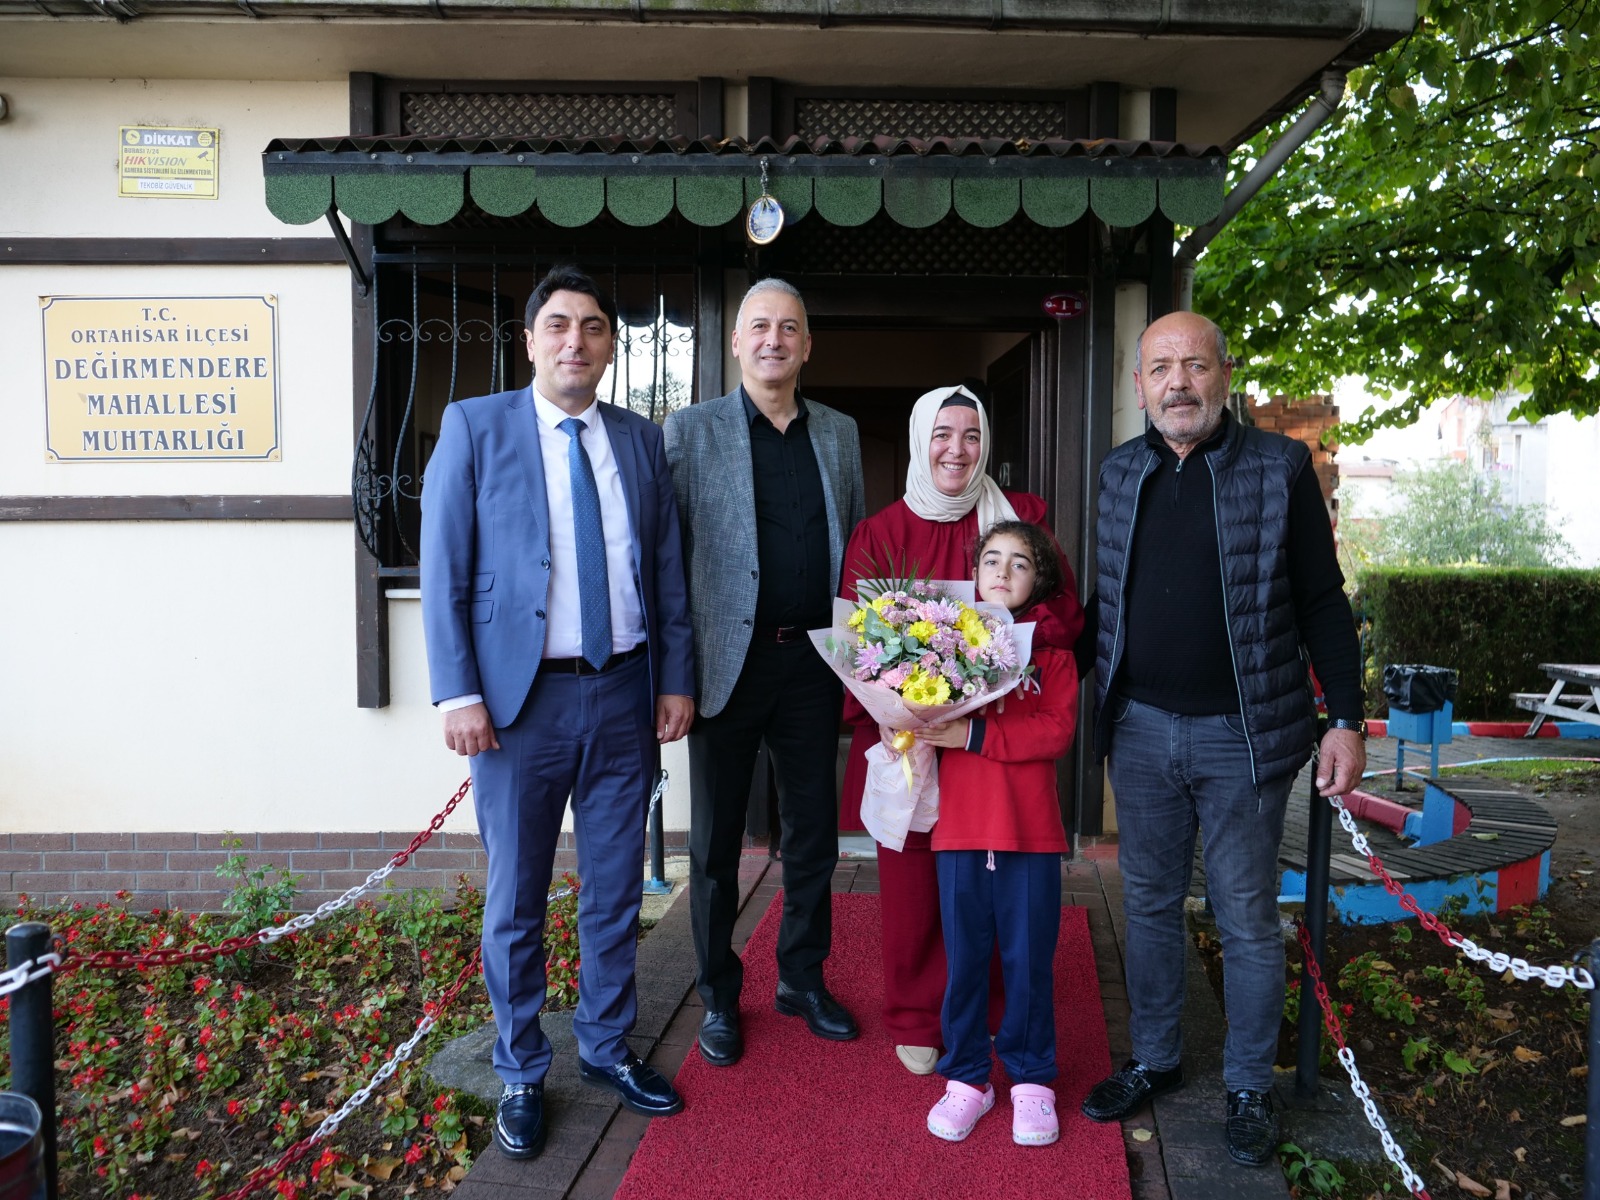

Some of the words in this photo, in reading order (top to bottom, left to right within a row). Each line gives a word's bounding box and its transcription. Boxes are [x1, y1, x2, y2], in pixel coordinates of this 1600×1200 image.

[143, 132, 193, 146] DİKKAT
[124, 155, 187, 167] HIKVISION
[141, 307, 177, 322] T.C.
[71, 325, 179, 344] ORTAHİSAR
[186, 324, 249, 346] İLÇESİ
[54, 351, 268, 380] DEĞİRMENDERE
[87, 386, 237, 415] MAHALLESİ
[82, 422, 245, 452] MUHTARLIĞI
